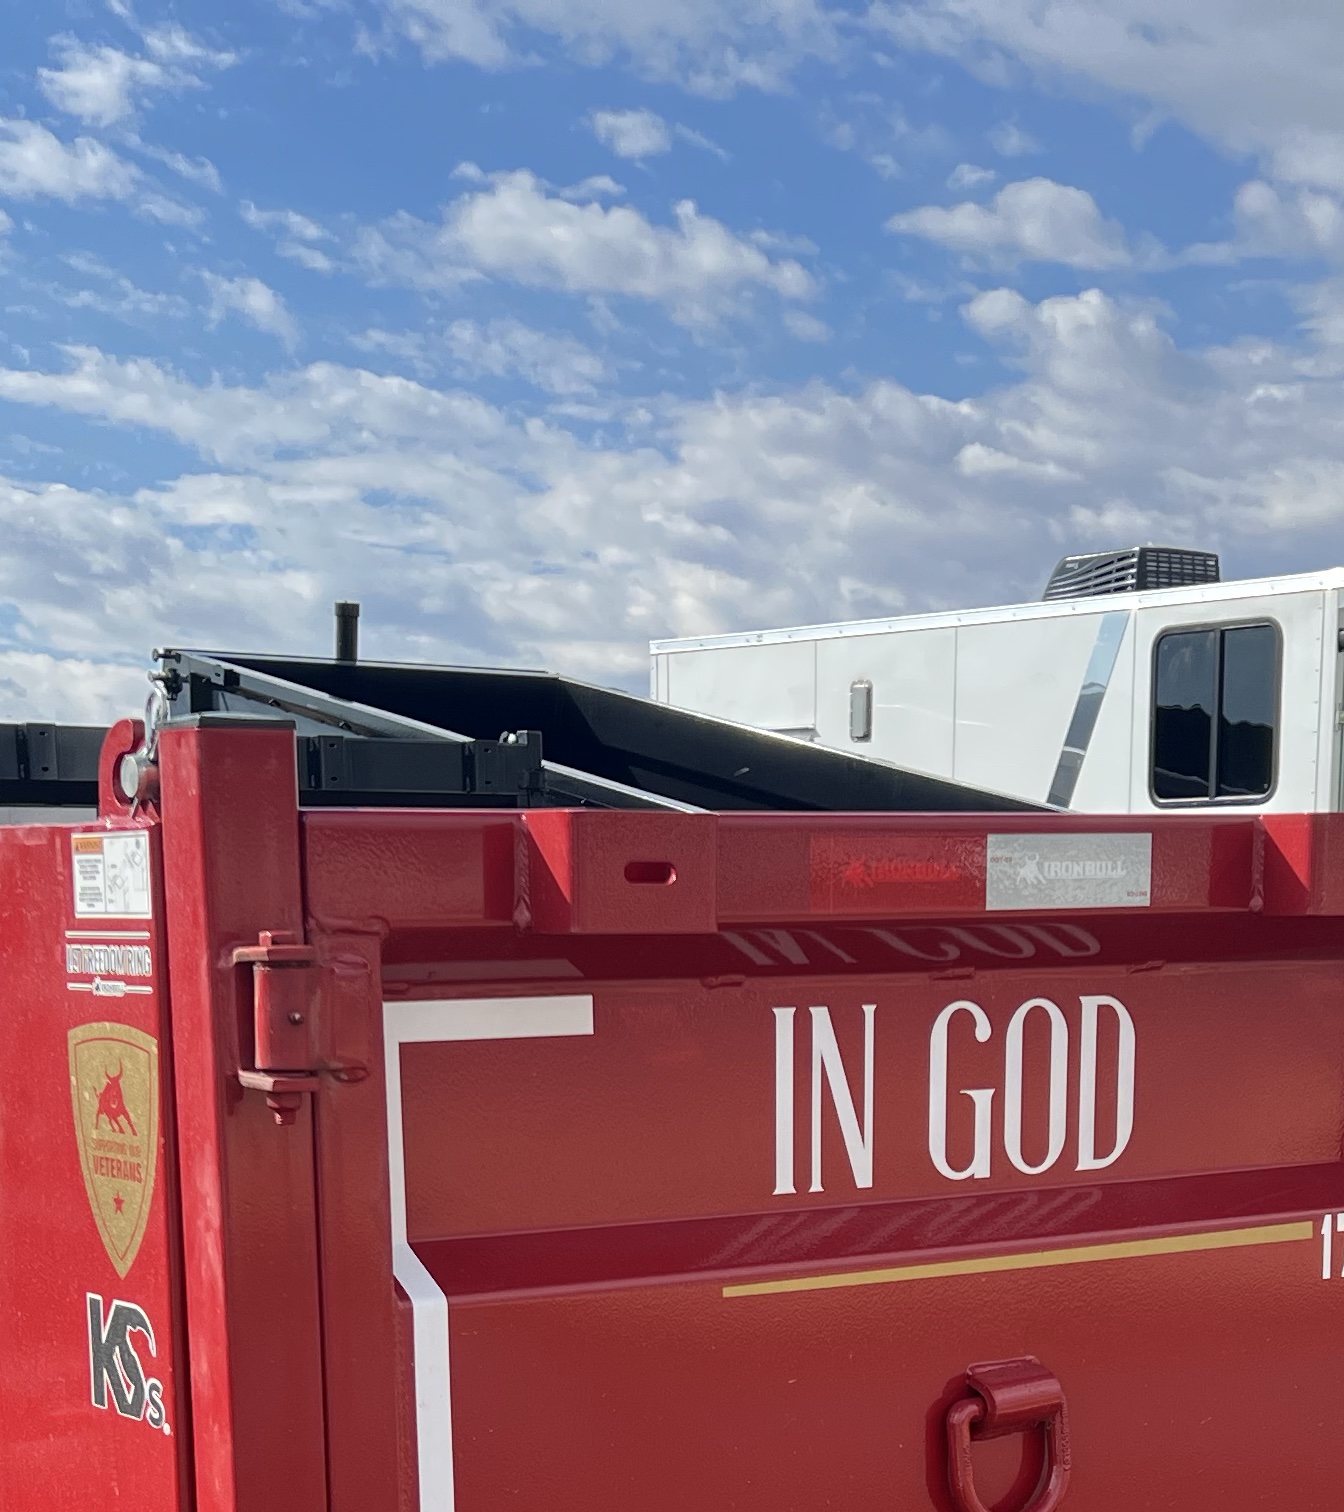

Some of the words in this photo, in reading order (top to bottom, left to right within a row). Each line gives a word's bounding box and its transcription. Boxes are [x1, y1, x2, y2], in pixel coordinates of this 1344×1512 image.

[1044, 855, 1127, 879] IRONBULL
[82, 945, 125, 975] FREEDOM
[125, 946, 152, 977] RING
[771, 1005, 878, 1195] IN
[928, 994, 1137, 1182] GOD
[93, 1155, 143, 1184] VETERANS
